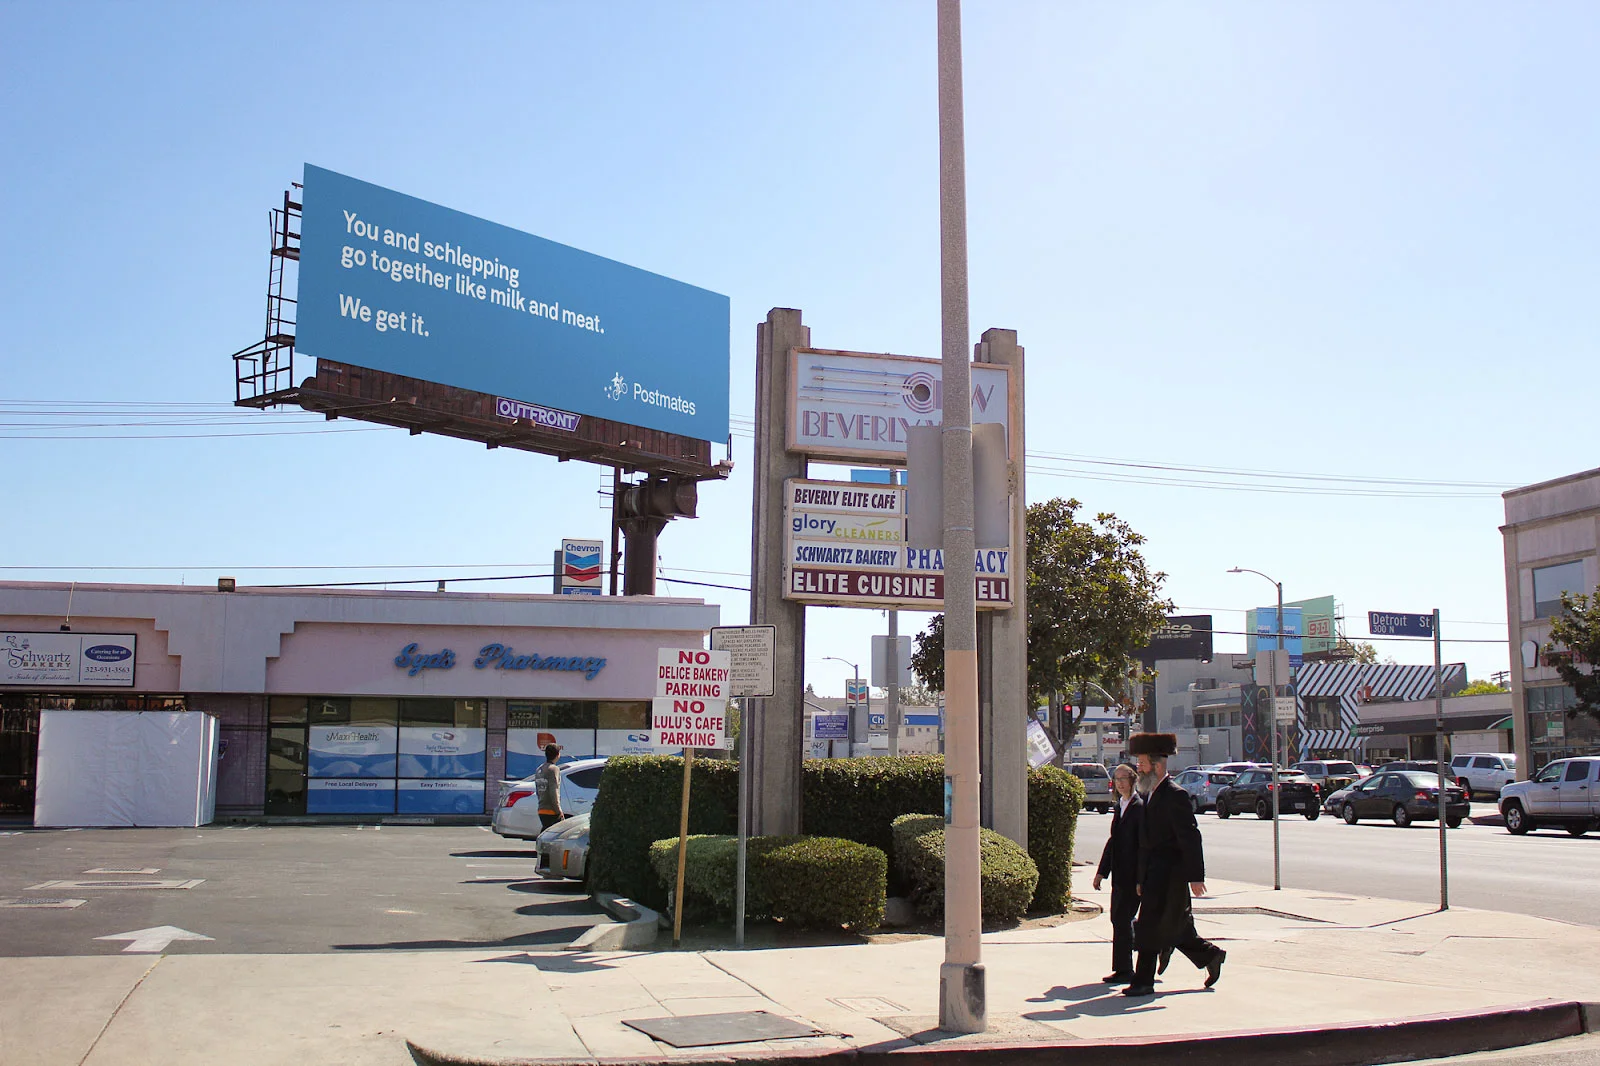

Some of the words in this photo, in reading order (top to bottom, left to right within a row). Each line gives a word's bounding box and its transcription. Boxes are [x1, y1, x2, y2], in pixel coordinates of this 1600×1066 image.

[343, 210, 379, 241] You
[383, 229, 419, 253] and
[423, 241, 520, 289] schlepping
[341, 246, 366, 269] go
[371, 250, 452, 290] together
[455, 273, 487, 300] like
[490, 287, 526, 312] milk
[529, 300, 559, 321] and
[562, 309, 605, 334] meat.
[339, 294, 372, 322] We
[375, 309, 407, 332] get
[411, 312, 430, 337] it.
[633, 383, 696, 416] Postmates
[499, 401, 576, 429] OUTFRONT
[794, 488, 840, 506] BEVERLY
[841, 491, 869, 508] ELITE
[871, 491, 896, 509] CAFÉ
[792, 513, 837, 534] glory
[834, 527, 900, 541] CLEANERS
[565, 543, 600, 552] Chevron
[795, 546, 853, 564] SCHWARTZ
[855, 549, 897, 566] BAKERY
[906, 547, 1008, 573] PHAACY
[793, 571, 849, 593] ELITE
[857, 575, 936, 597] CUISINE
[978, 580, 1006, 599] ELI
[1372, 613, 1408, 627] Detroit
[1419, 616, 1430, 628] St
[1373, 625, 1387, 633] 300
[1389, 625, 1395, 633] N
[8, 648, 71, 668] Schwartz
[395, 642, 456, 677] Syd's
[474, 643, 608, 680] Pharmacy
[678, 651, 710, 665] NO
[659, 666, 691, 681] DELICE
[693, 667, 729, 682] BAKERY
[665, 682, 721, 697] PARKING
[673, 700, 705, 714] NO
[654, 715, 692, 730] LULU'S
[695, 717, 723, 731] CAFE
[351, 732, 378, 741] Health
[660, 732, 716, 746] PARKING
